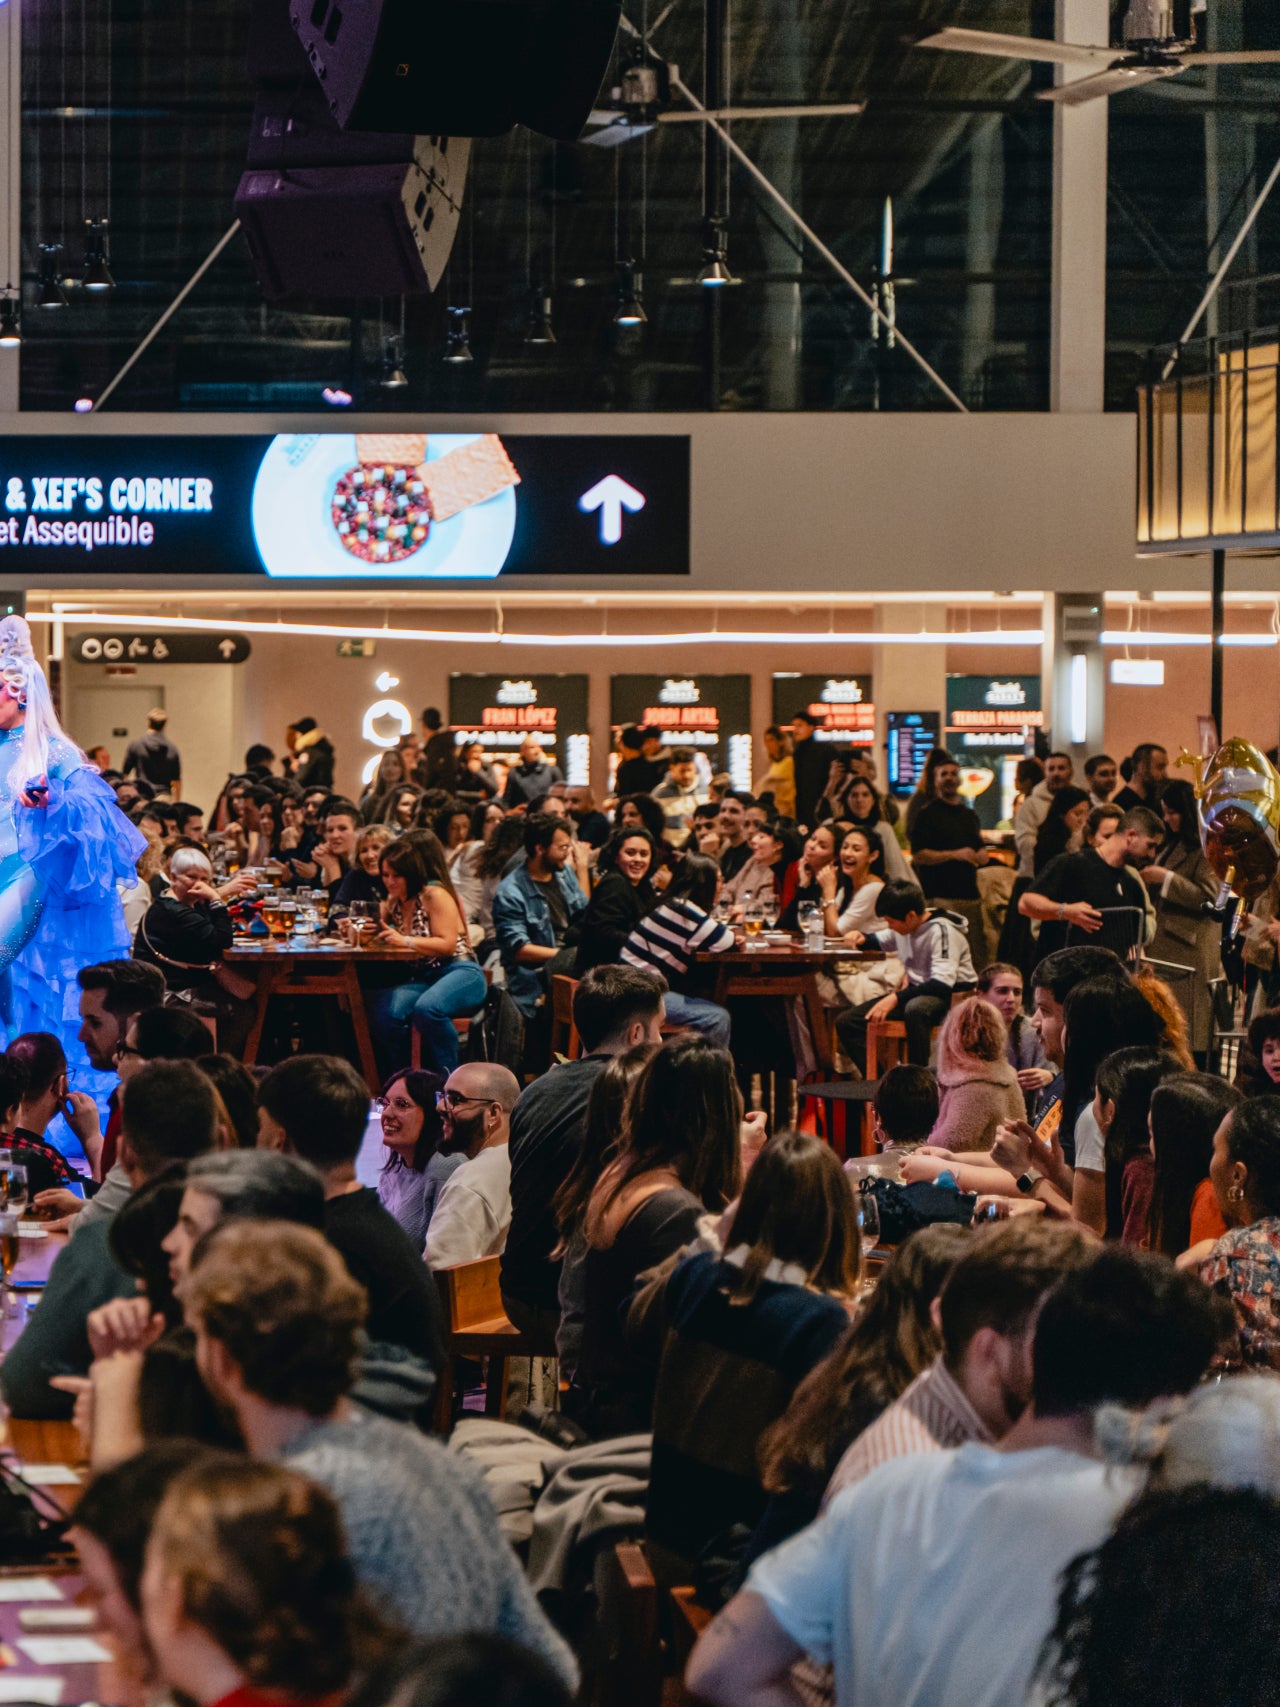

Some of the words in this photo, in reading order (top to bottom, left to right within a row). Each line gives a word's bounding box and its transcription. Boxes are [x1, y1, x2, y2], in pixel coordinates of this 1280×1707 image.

[6, 477, 26, 510] &
[31, 477, 103, 510] XEF'S
[109, 477, 213, 510] CORNER
[22, 515, 154, 551] Assequible
